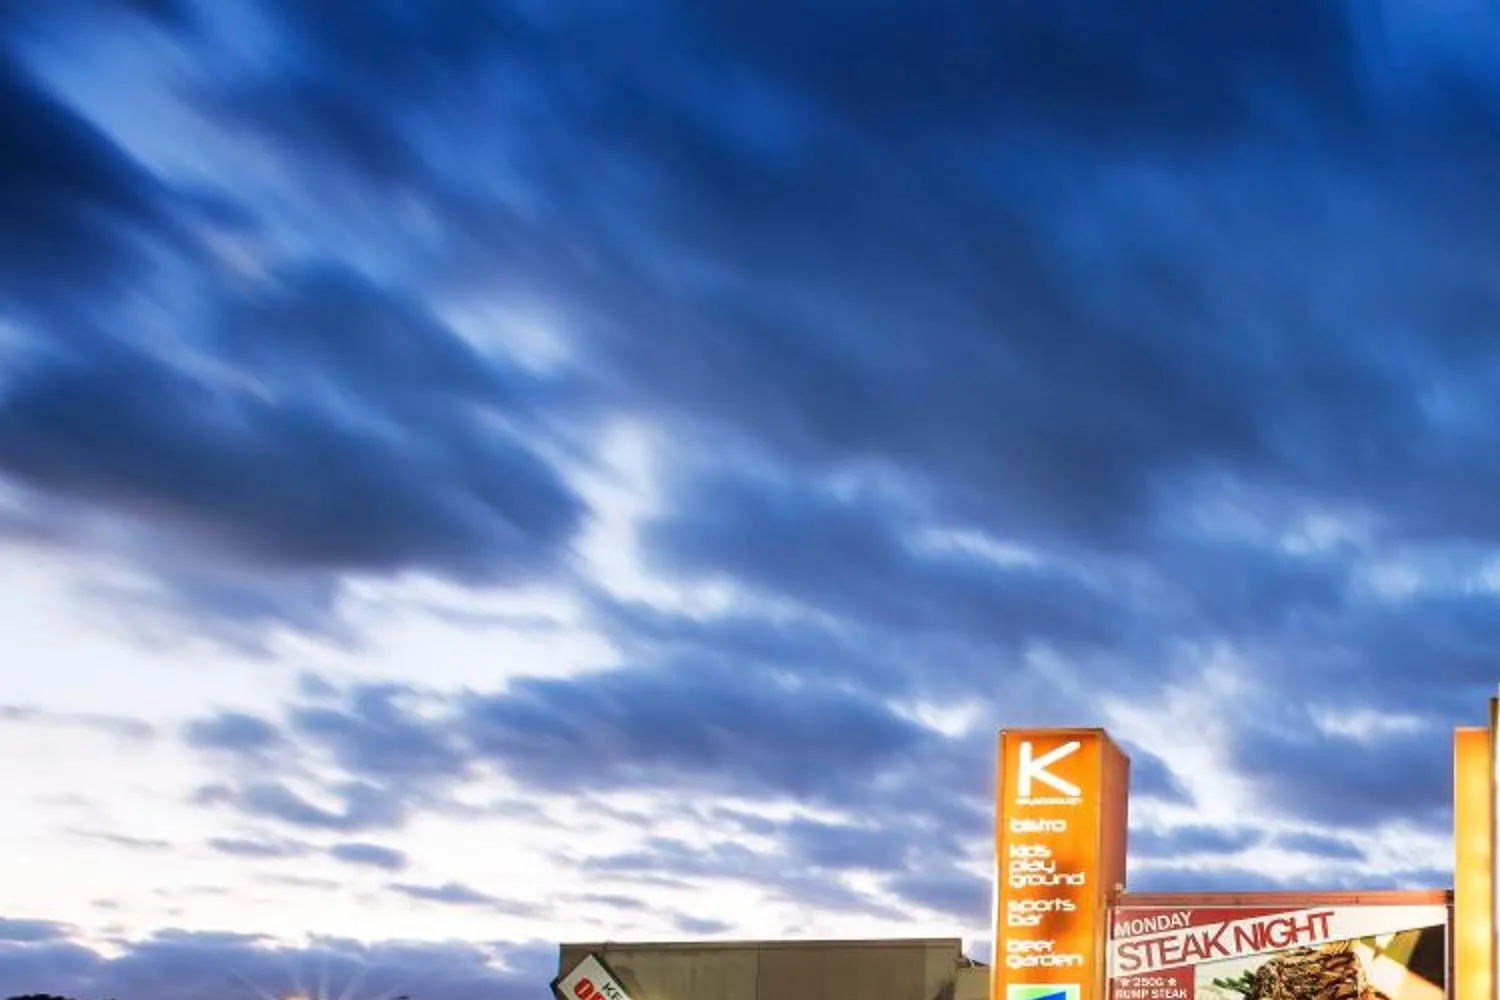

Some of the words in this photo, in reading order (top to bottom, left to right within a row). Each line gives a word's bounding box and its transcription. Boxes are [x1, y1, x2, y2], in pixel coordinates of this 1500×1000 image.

[1018, 741, 1082, 797] K
[1008, 872, 1086, 888] ground
[1009, 858, 1056, 874] play
[1114, 910, 1193, 939] MONDAY
[1118, 922, 1231, 971] STEAK
[1233, 911, 1334, 953] NIGHT
